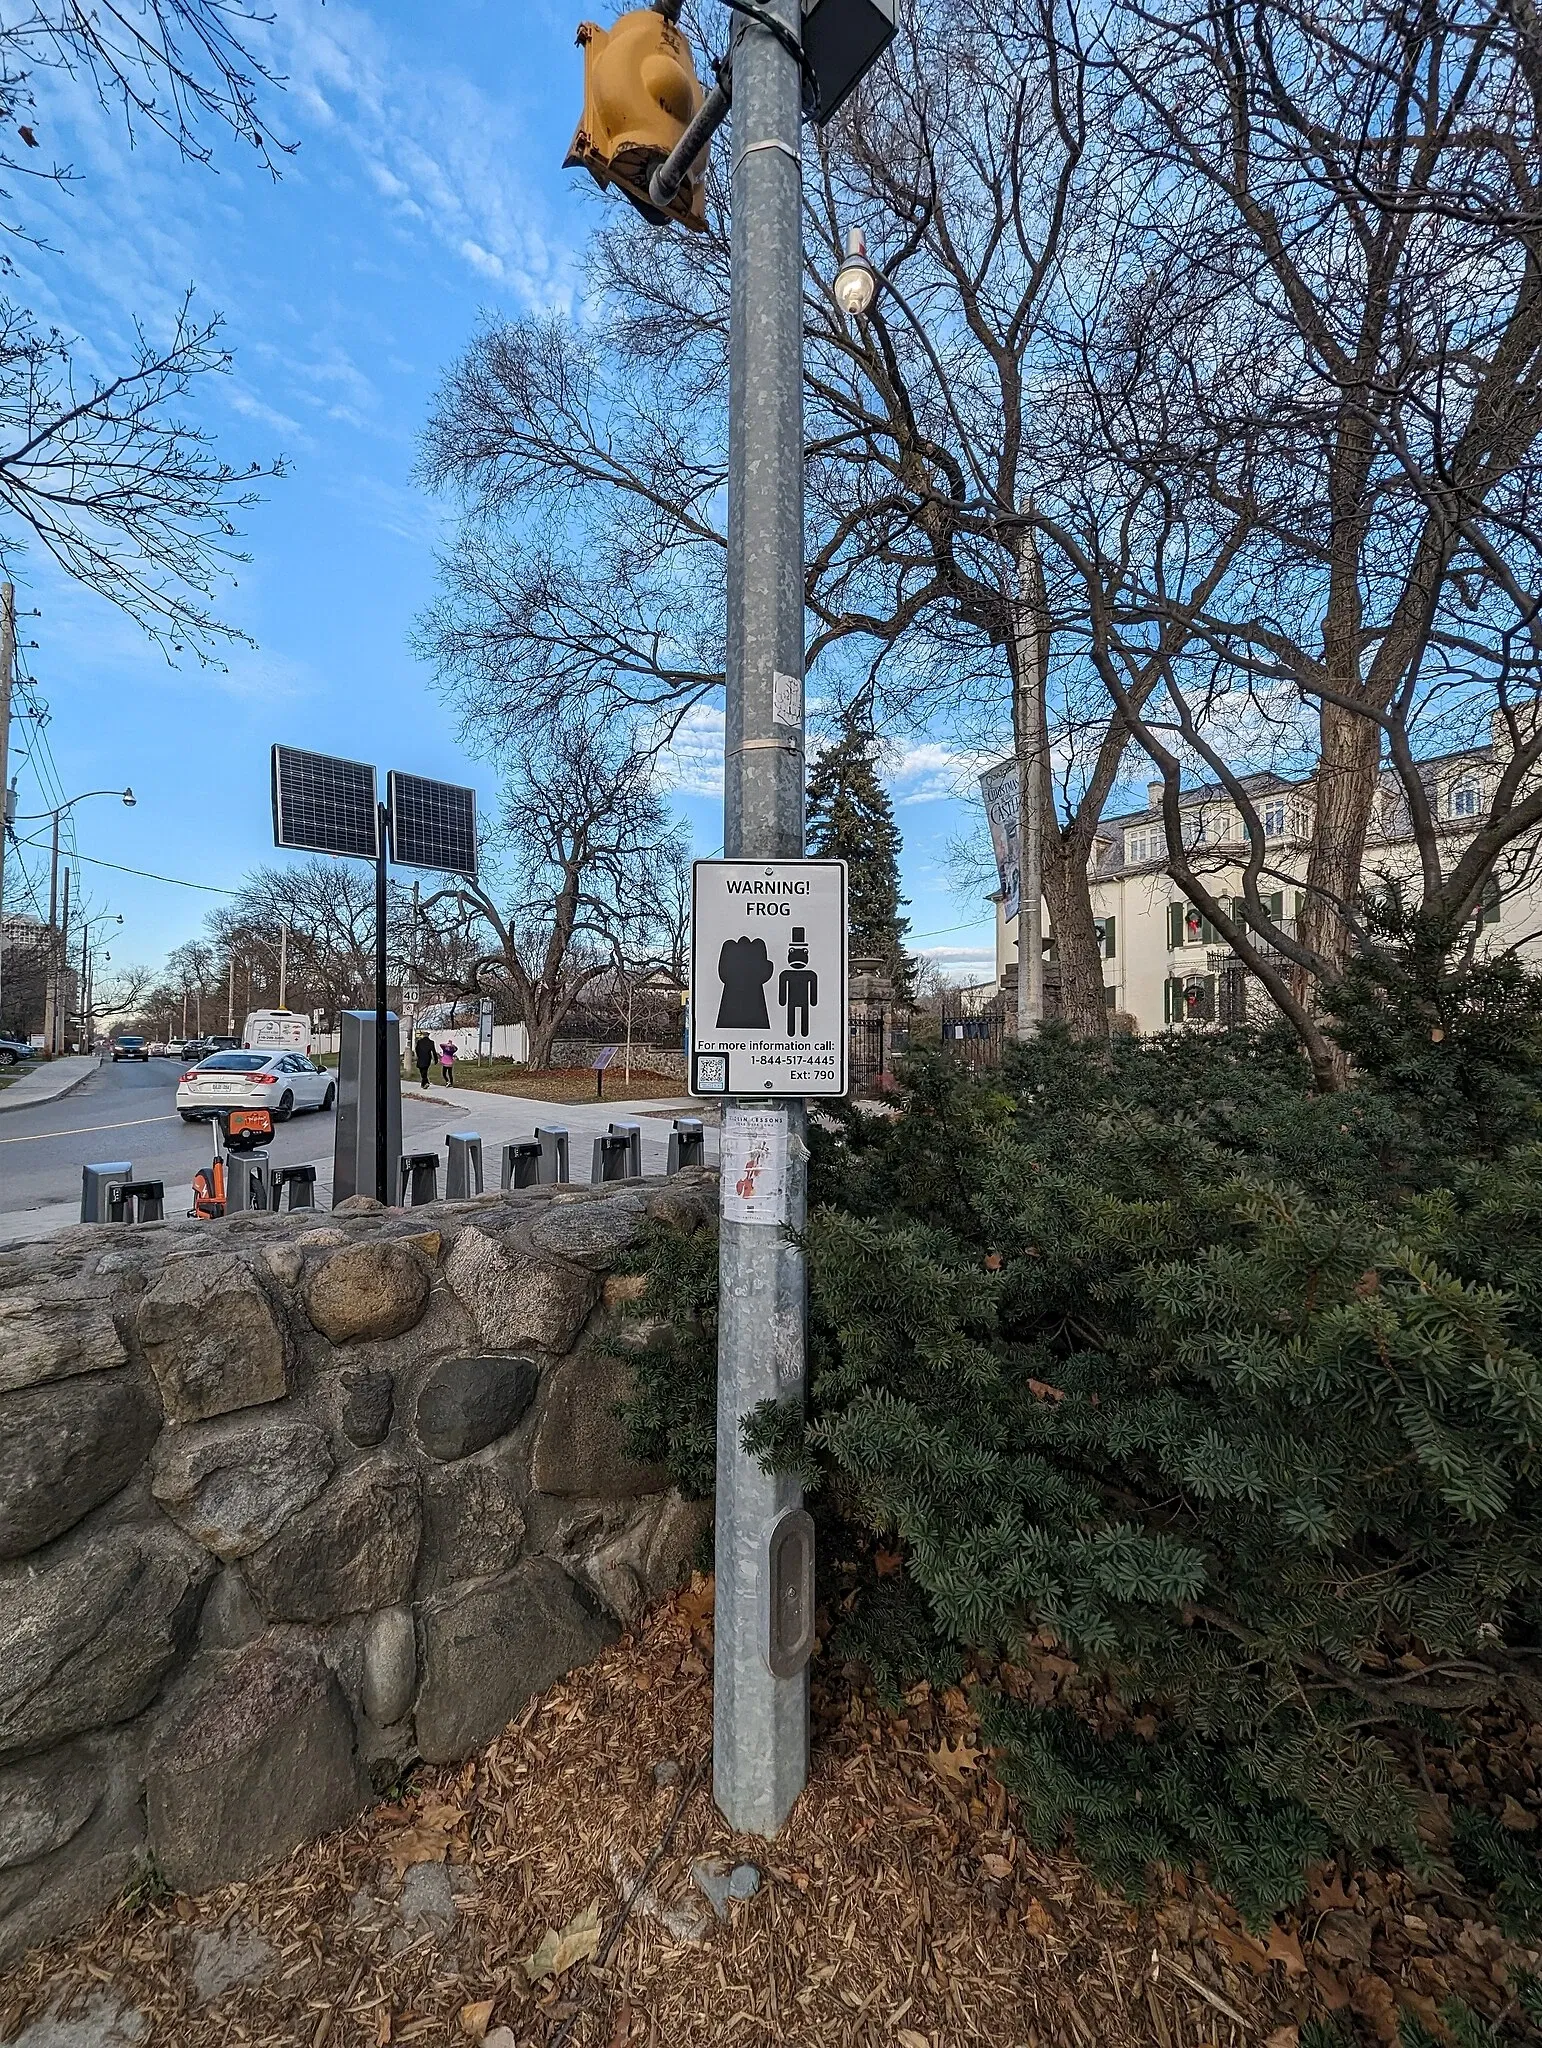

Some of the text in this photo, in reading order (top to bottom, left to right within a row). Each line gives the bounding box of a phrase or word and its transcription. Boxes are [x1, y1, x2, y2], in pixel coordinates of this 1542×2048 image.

[987, 779, 1019, 802] CHRISTMAS
[727, 880, 810, 895] WARNING!
[746, 902, 791, 916] FROG
[404, 991, 418, 1001] 40
[698, 1040, 835, 1051] For more information call:
[751, 1055, 835, 1066] 1-844-517-4445
[790, 1070, 835, 1080] Ext: 790
